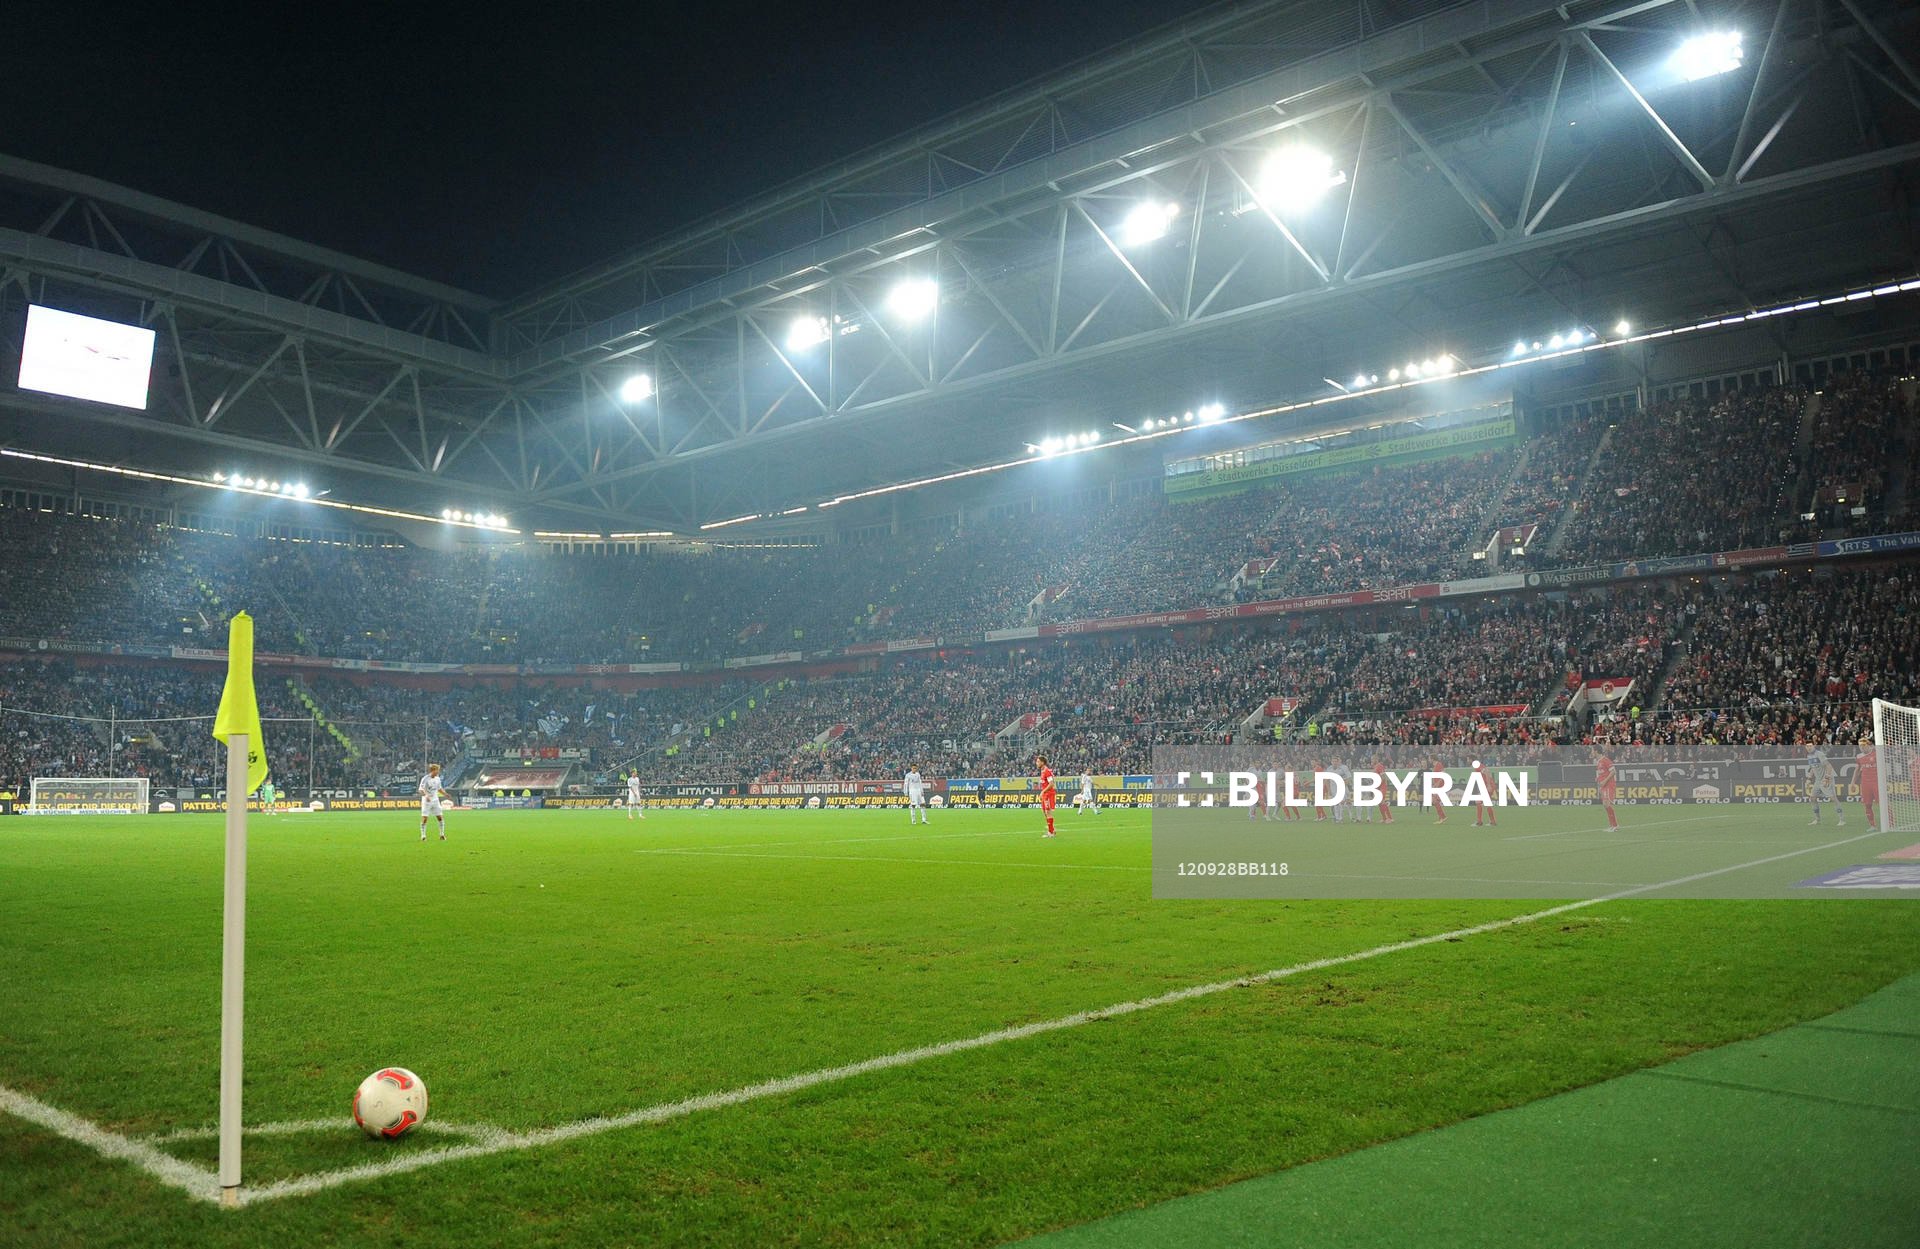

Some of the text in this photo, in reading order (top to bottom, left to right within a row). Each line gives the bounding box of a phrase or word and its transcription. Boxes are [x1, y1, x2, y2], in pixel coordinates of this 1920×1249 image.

[1388, 422, 1511, 453] Stadtwerke Düsseldorf
[1218, 456, 1321, 482] Stadtwerke Düssedorf
[1877, 538, 1897, 548] The
[1543, 569, 1610, 584] WARSTEINER
[1372, 588, 1413, 602] ESPRIT
[1206, 606, 1240, 619] ESPRIT
[1056, 622, 1086, 634] ESPRIT
[1161, 793, 1178, 803] DIR
[1538, 788, 1571, 800] GIBT
[1573, 787, 1597, 799] DIR
[1628, 786, 1679, 798] KRAFT
[276, 801, 303, 809] KRAFT
[950, 795, 983, 805] PATTEX
